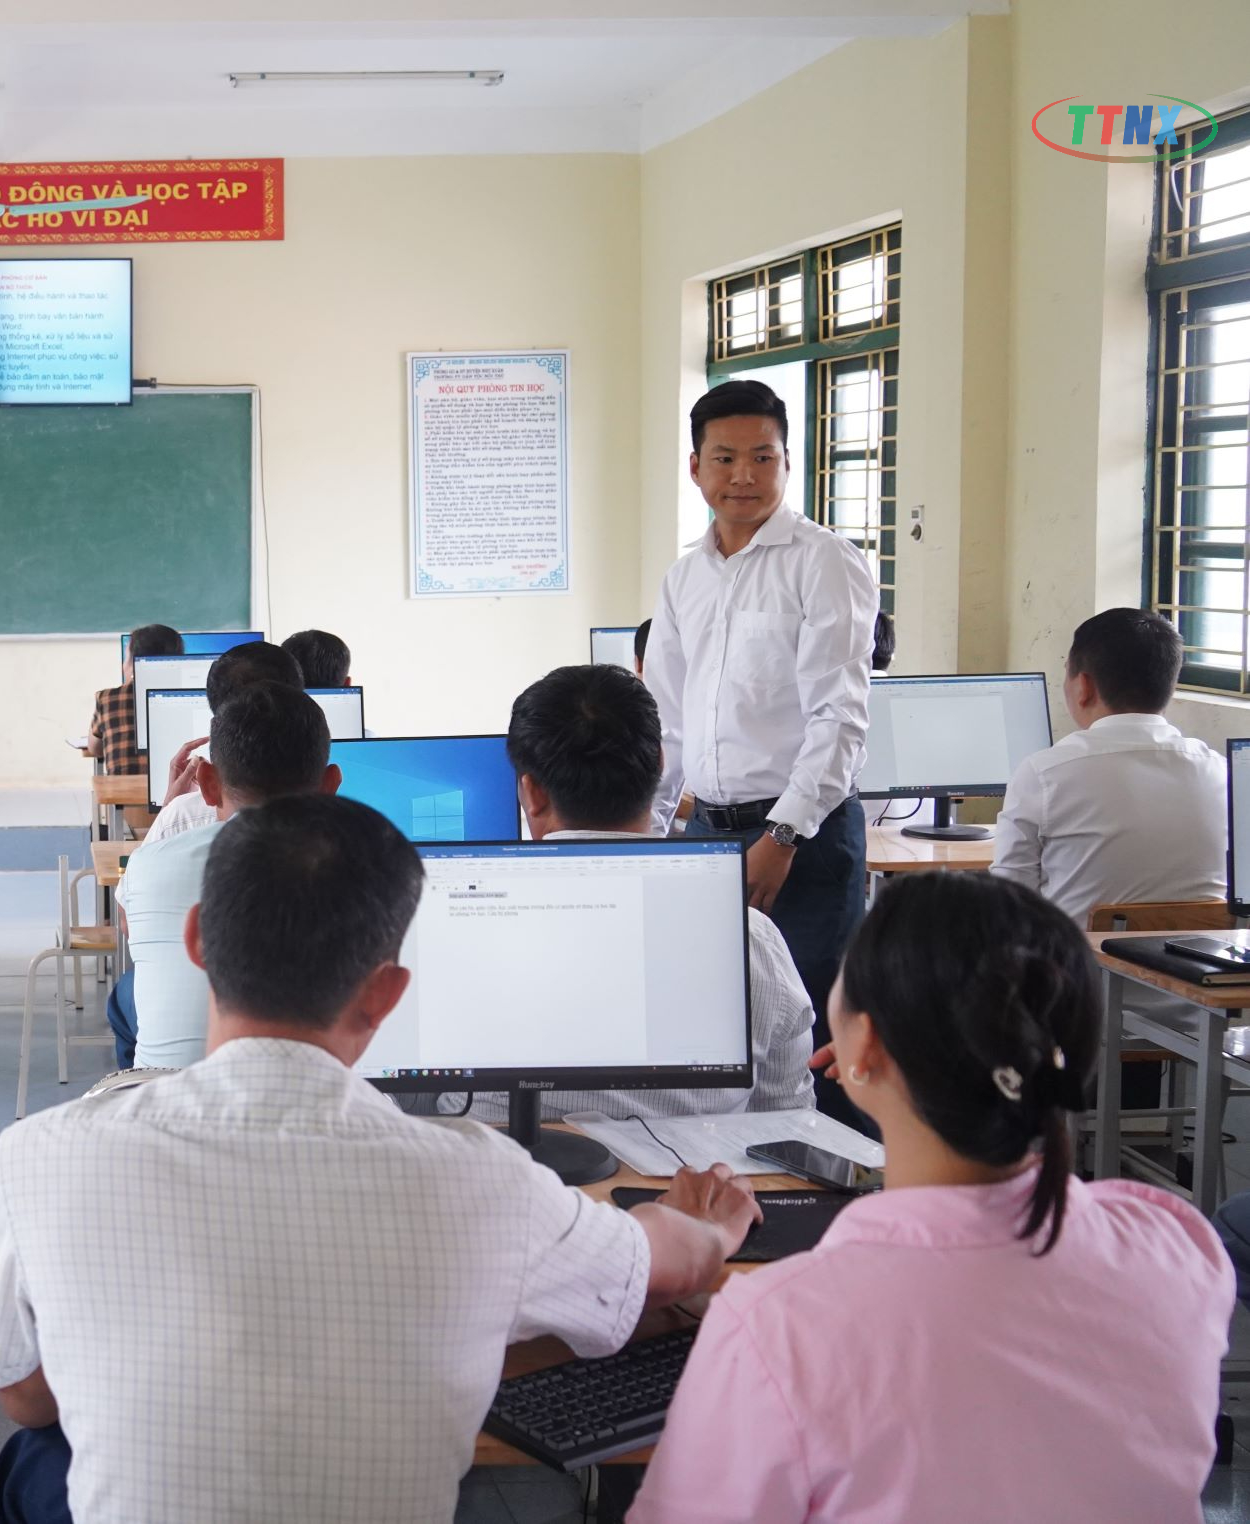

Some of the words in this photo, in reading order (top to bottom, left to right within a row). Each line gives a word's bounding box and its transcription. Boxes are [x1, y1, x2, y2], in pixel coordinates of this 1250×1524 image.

[136, 183, 189, 205] HỌC
[197, 178, 248, 204] TẬP
[104, 209, 148, 231] ĐẠI
[457, 385, 475, 393] QUY
[477, 383, 507, 393] PHÒNG
[509, 384, 524, 392] TIN
[527, 384, 545, 393] HỌC
